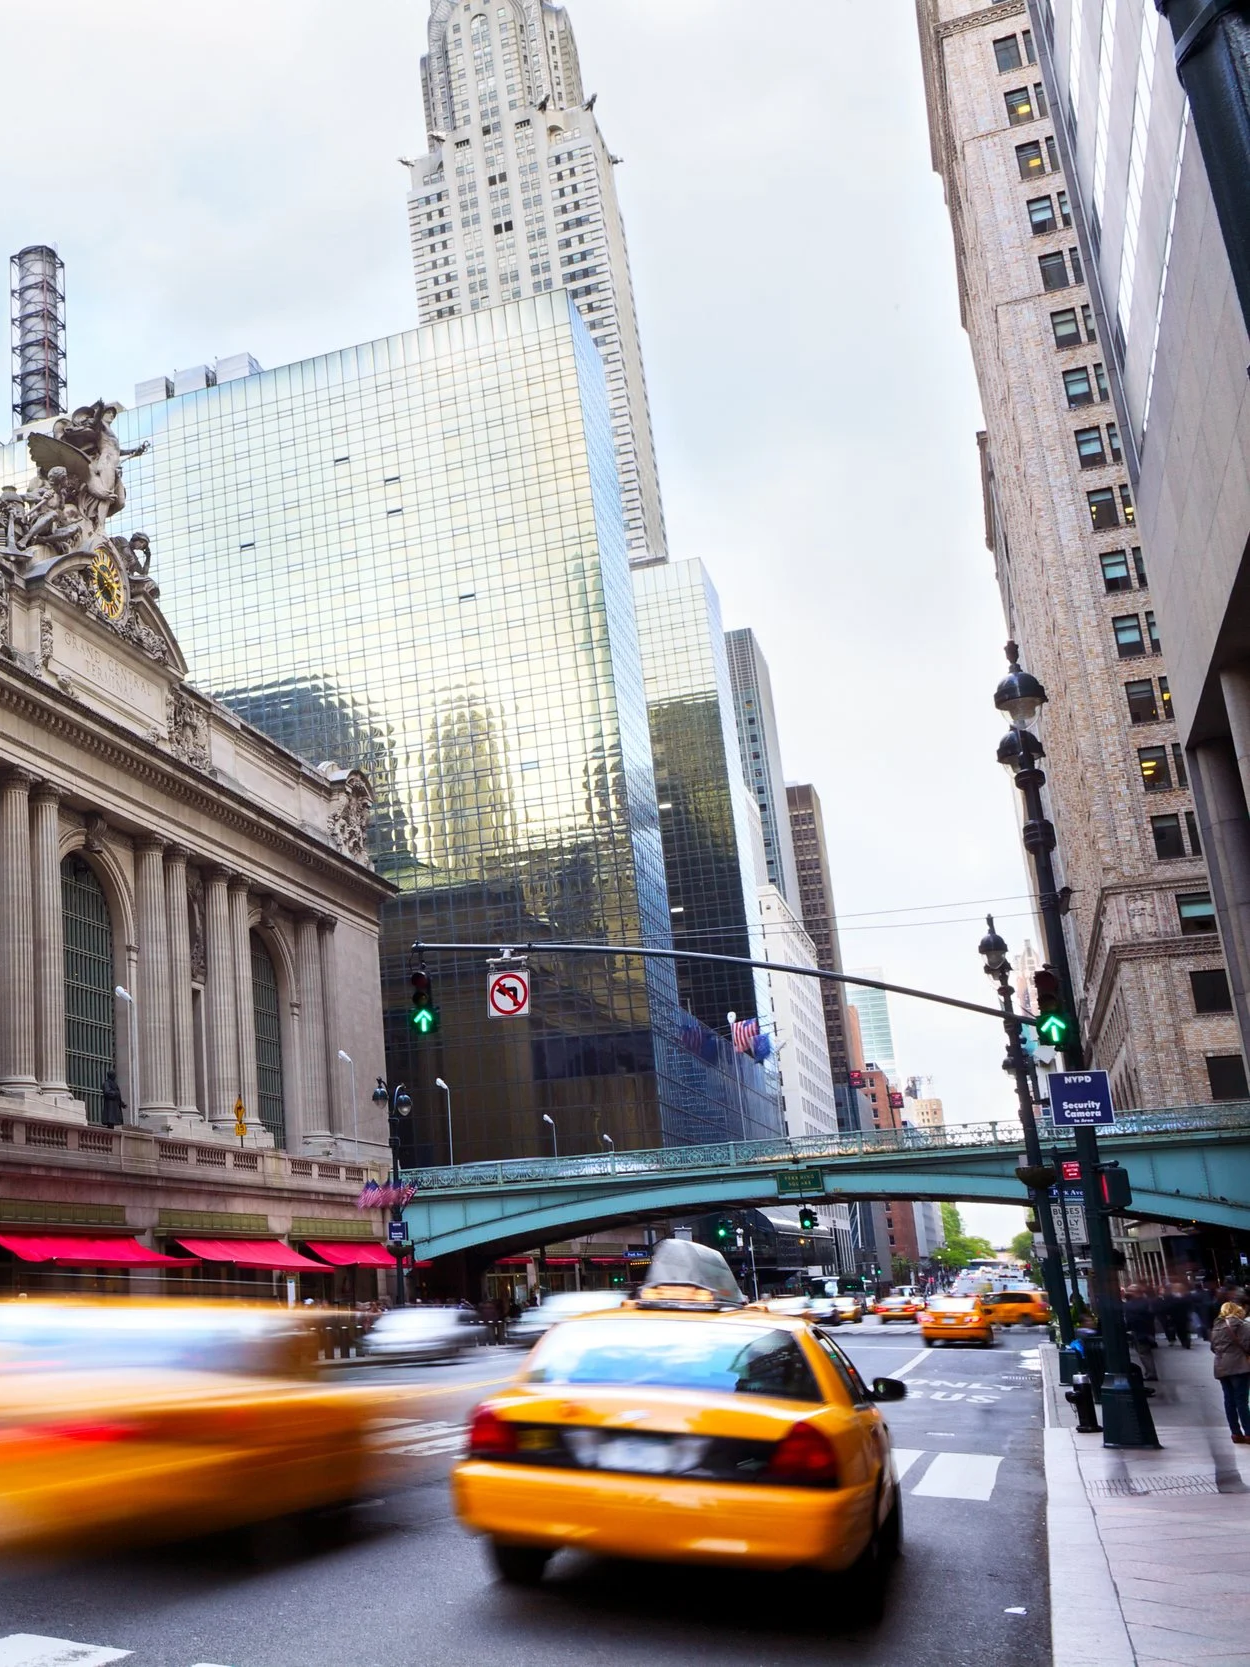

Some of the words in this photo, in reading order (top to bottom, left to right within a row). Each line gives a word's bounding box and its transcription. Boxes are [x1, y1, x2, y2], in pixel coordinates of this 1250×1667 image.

[64, 632, 101, 664] GRAND
[109, 660, 152, 697] CENTRAL
[85, 660, 135, 700] TERMINAL
[1064, 1075, 1092, 1084] NYPD
[1062, 1100, 1101, 1110] Security
[1064, 1110, 1102, 1118] Camera
[1056, 1219, 1079, 1227] OLY
[903, 1378, 1023, 1391] ONLY
